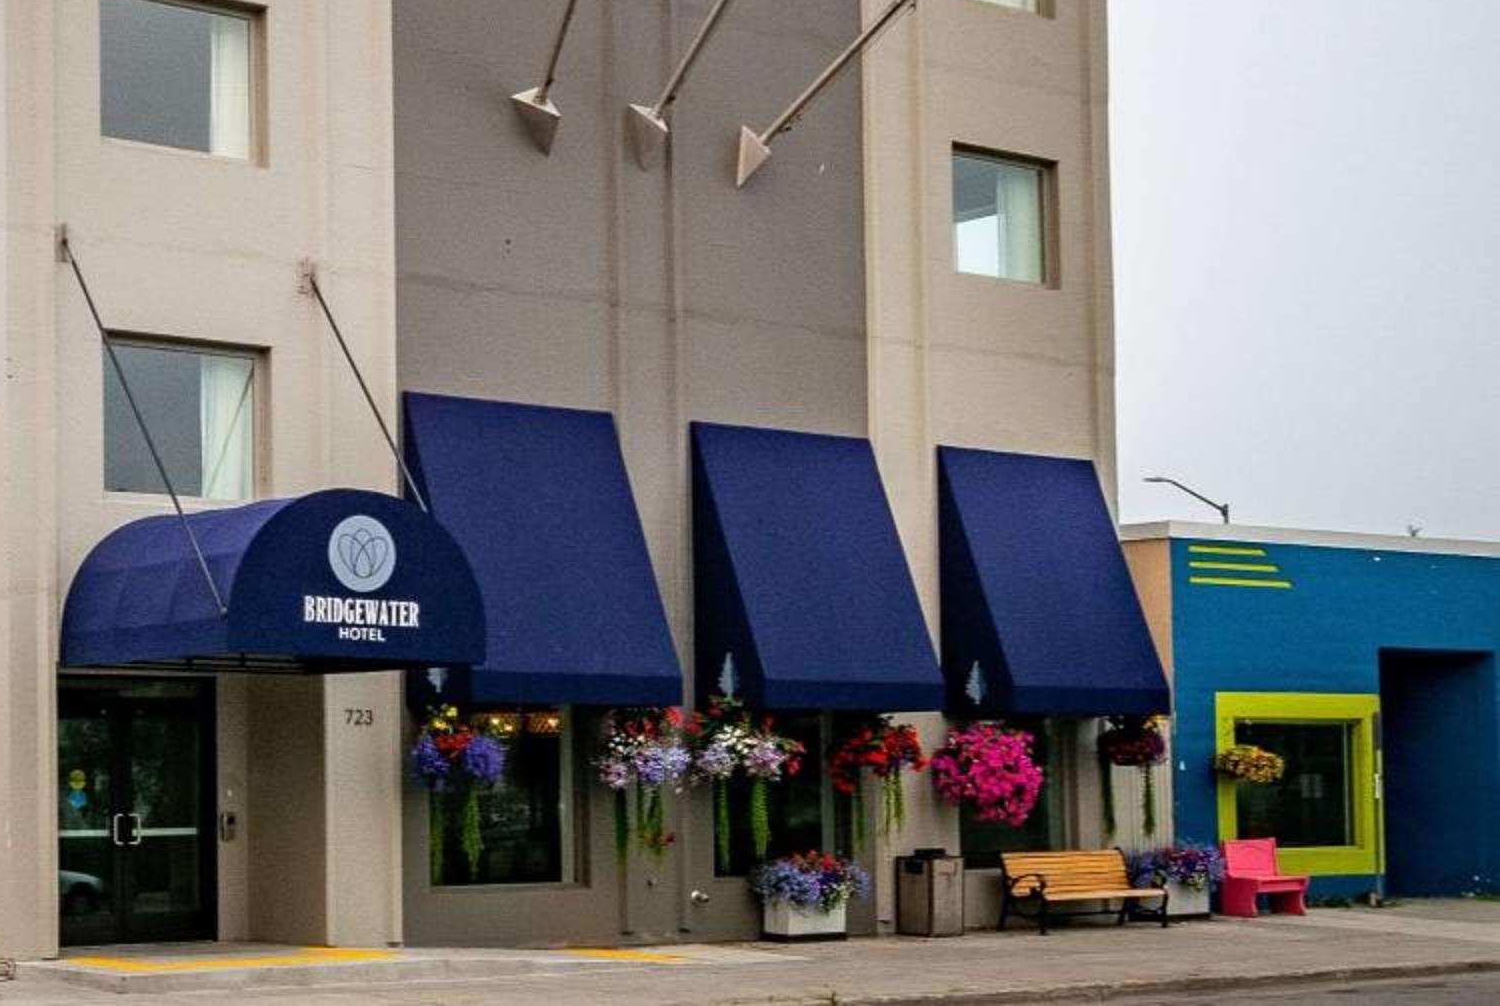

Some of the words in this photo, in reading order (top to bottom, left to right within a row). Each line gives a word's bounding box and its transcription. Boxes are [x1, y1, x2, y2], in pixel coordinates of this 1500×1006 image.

[303, 595, 420, 628] BRIDGEWATER
[338, 626, 386, 642] HOTEL
[344, 708, 373, 726] 723
